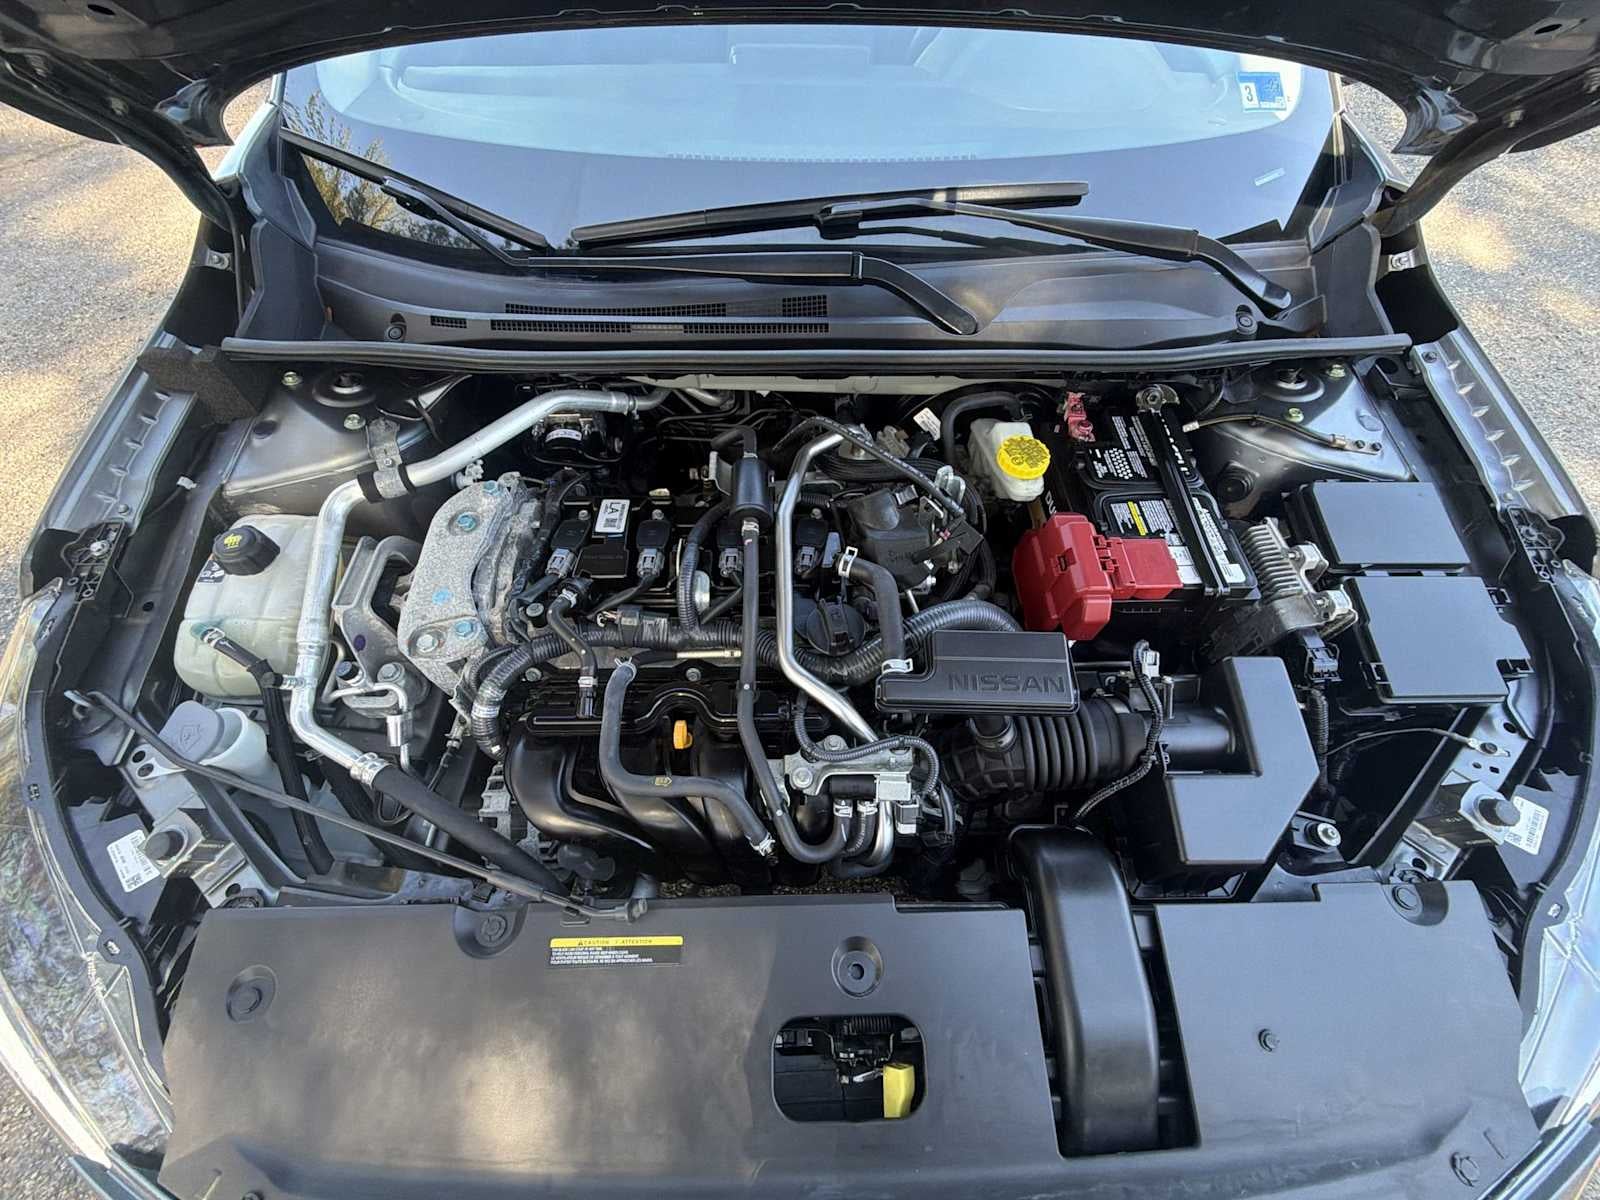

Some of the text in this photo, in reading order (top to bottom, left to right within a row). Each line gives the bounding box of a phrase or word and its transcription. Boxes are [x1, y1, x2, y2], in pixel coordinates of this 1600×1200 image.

[1244, 85, 1254, 102] 3
[607, 502, 622, 515] LA
[1045, 490, 1057, 514] DU
[947, 673, 1066, 693] NISSAN
